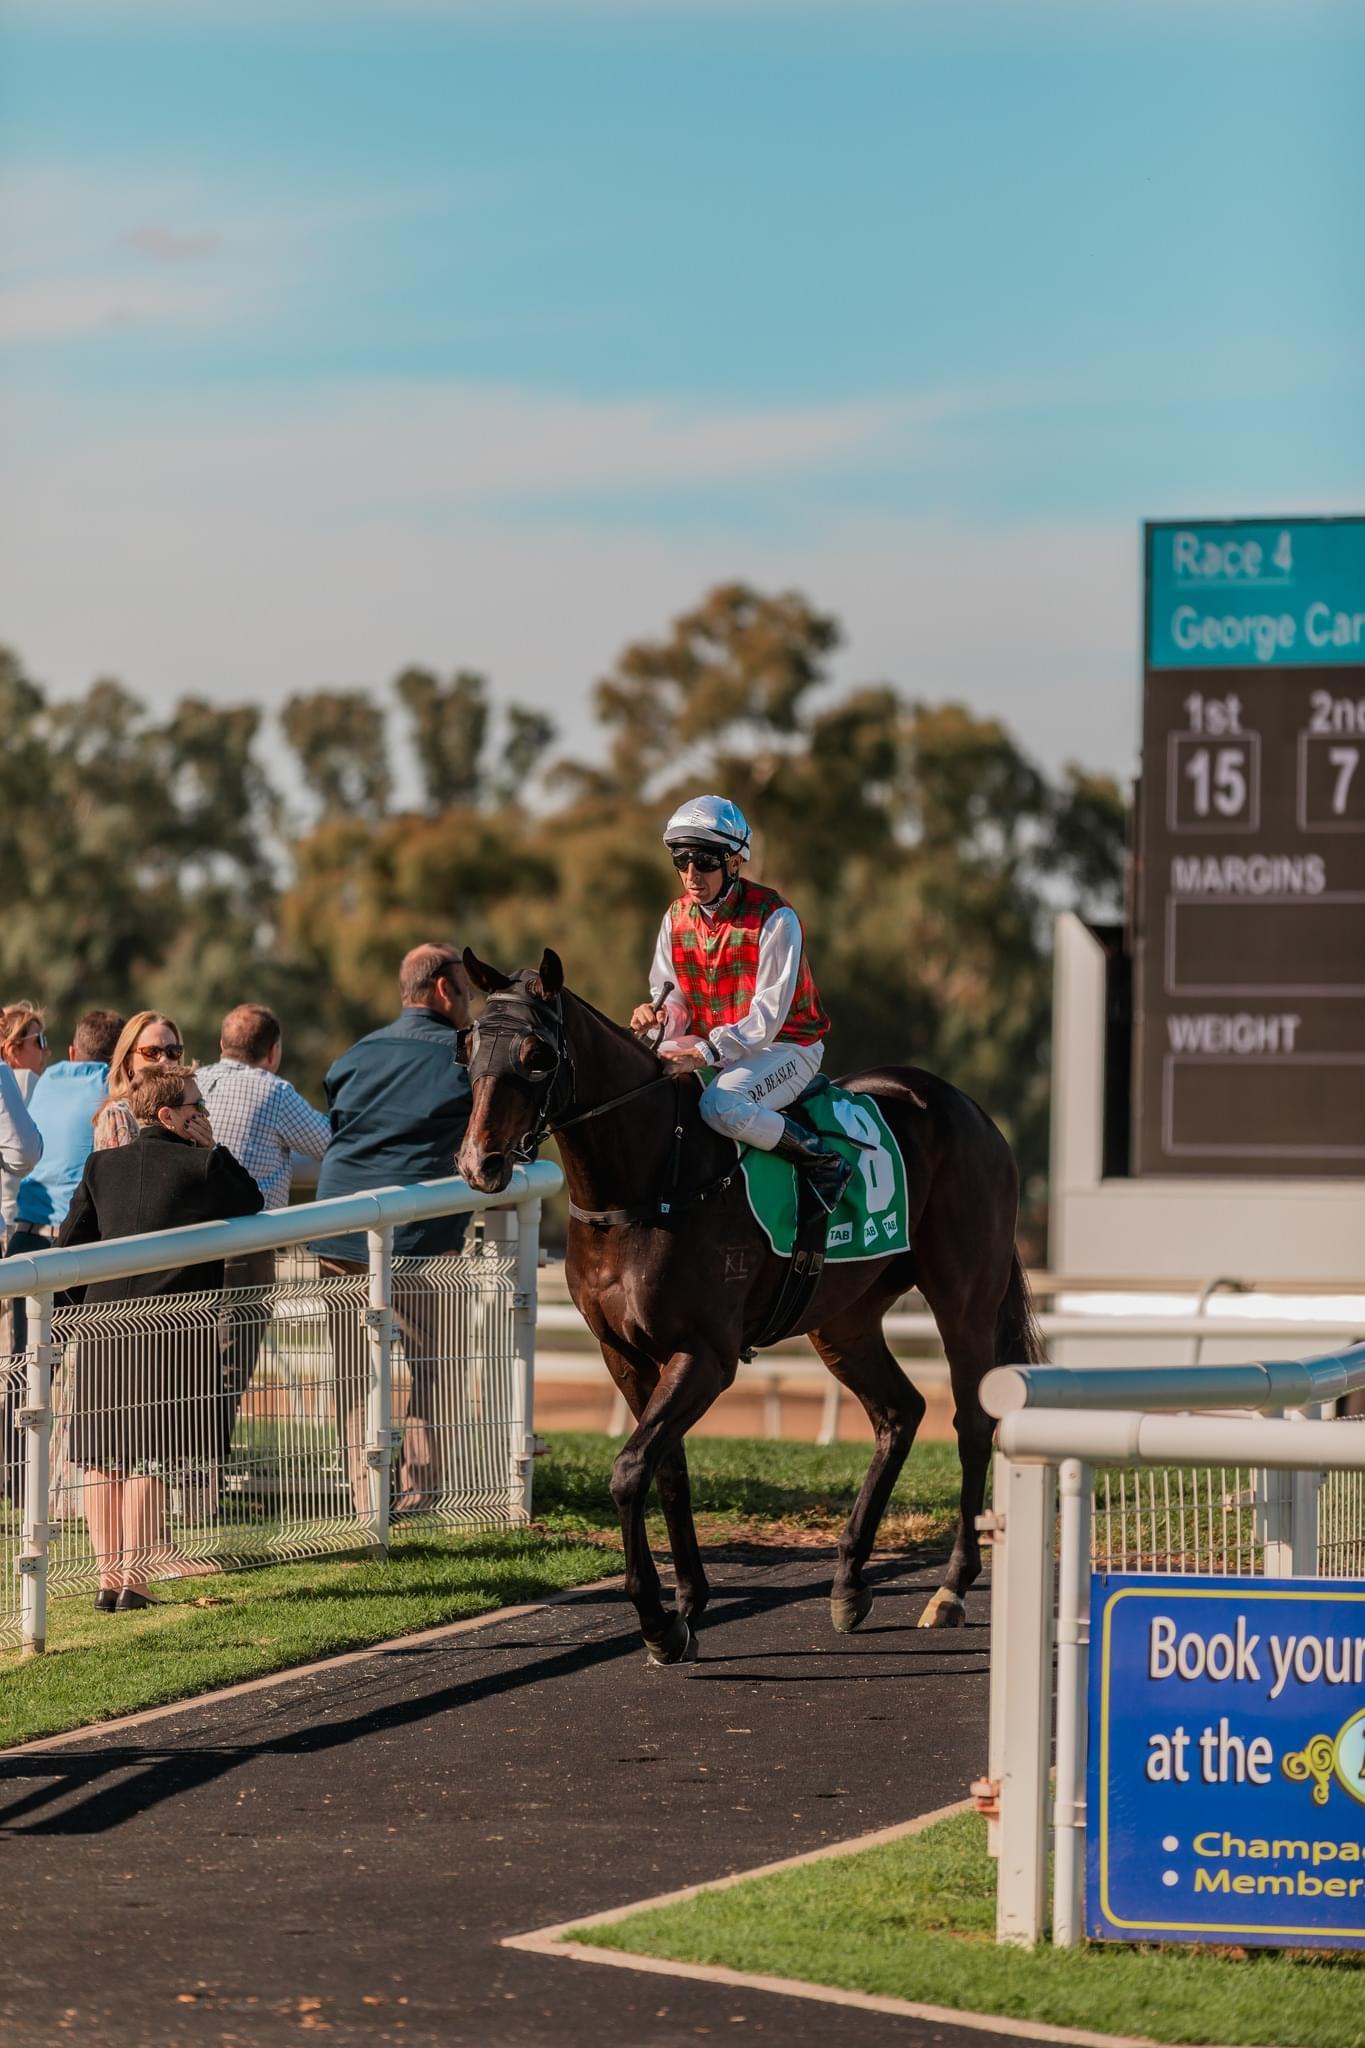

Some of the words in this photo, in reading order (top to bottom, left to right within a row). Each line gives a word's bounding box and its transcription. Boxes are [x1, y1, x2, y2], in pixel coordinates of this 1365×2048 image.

[1173, 531, 1262, 577] Race
[1272, 530, 1293, 570] 4
[1171, 604, 1296, 663] George
[1185, 691, 1242, 735] 1st
[1185, 748, 1246, 816] 15
[1329, 747, 1359, 814] 7
[1171, 854, 1326, 895] MARGINS
[1167, 1013, 1300, 1054] WEIGHT
[764, 1059, 798, 1093] BEASLEY
[832, 1098, 896, 1214] 8
[830, 1230, 850, 1241] TAB
[864, 1226, 877, 1238] AB
[883, 1220, 897, 1232] TAB
[1150, 1615, 1261, 1680] Book
[1269, 1634, 1365, 1700] your
[1146, 1726, 1190, 1783] at
[1199, 1717, 1273, 1785] the
[1192, 1832, 1365, 1866] Champa
[1194, 1868, 1365, 1898] Member
